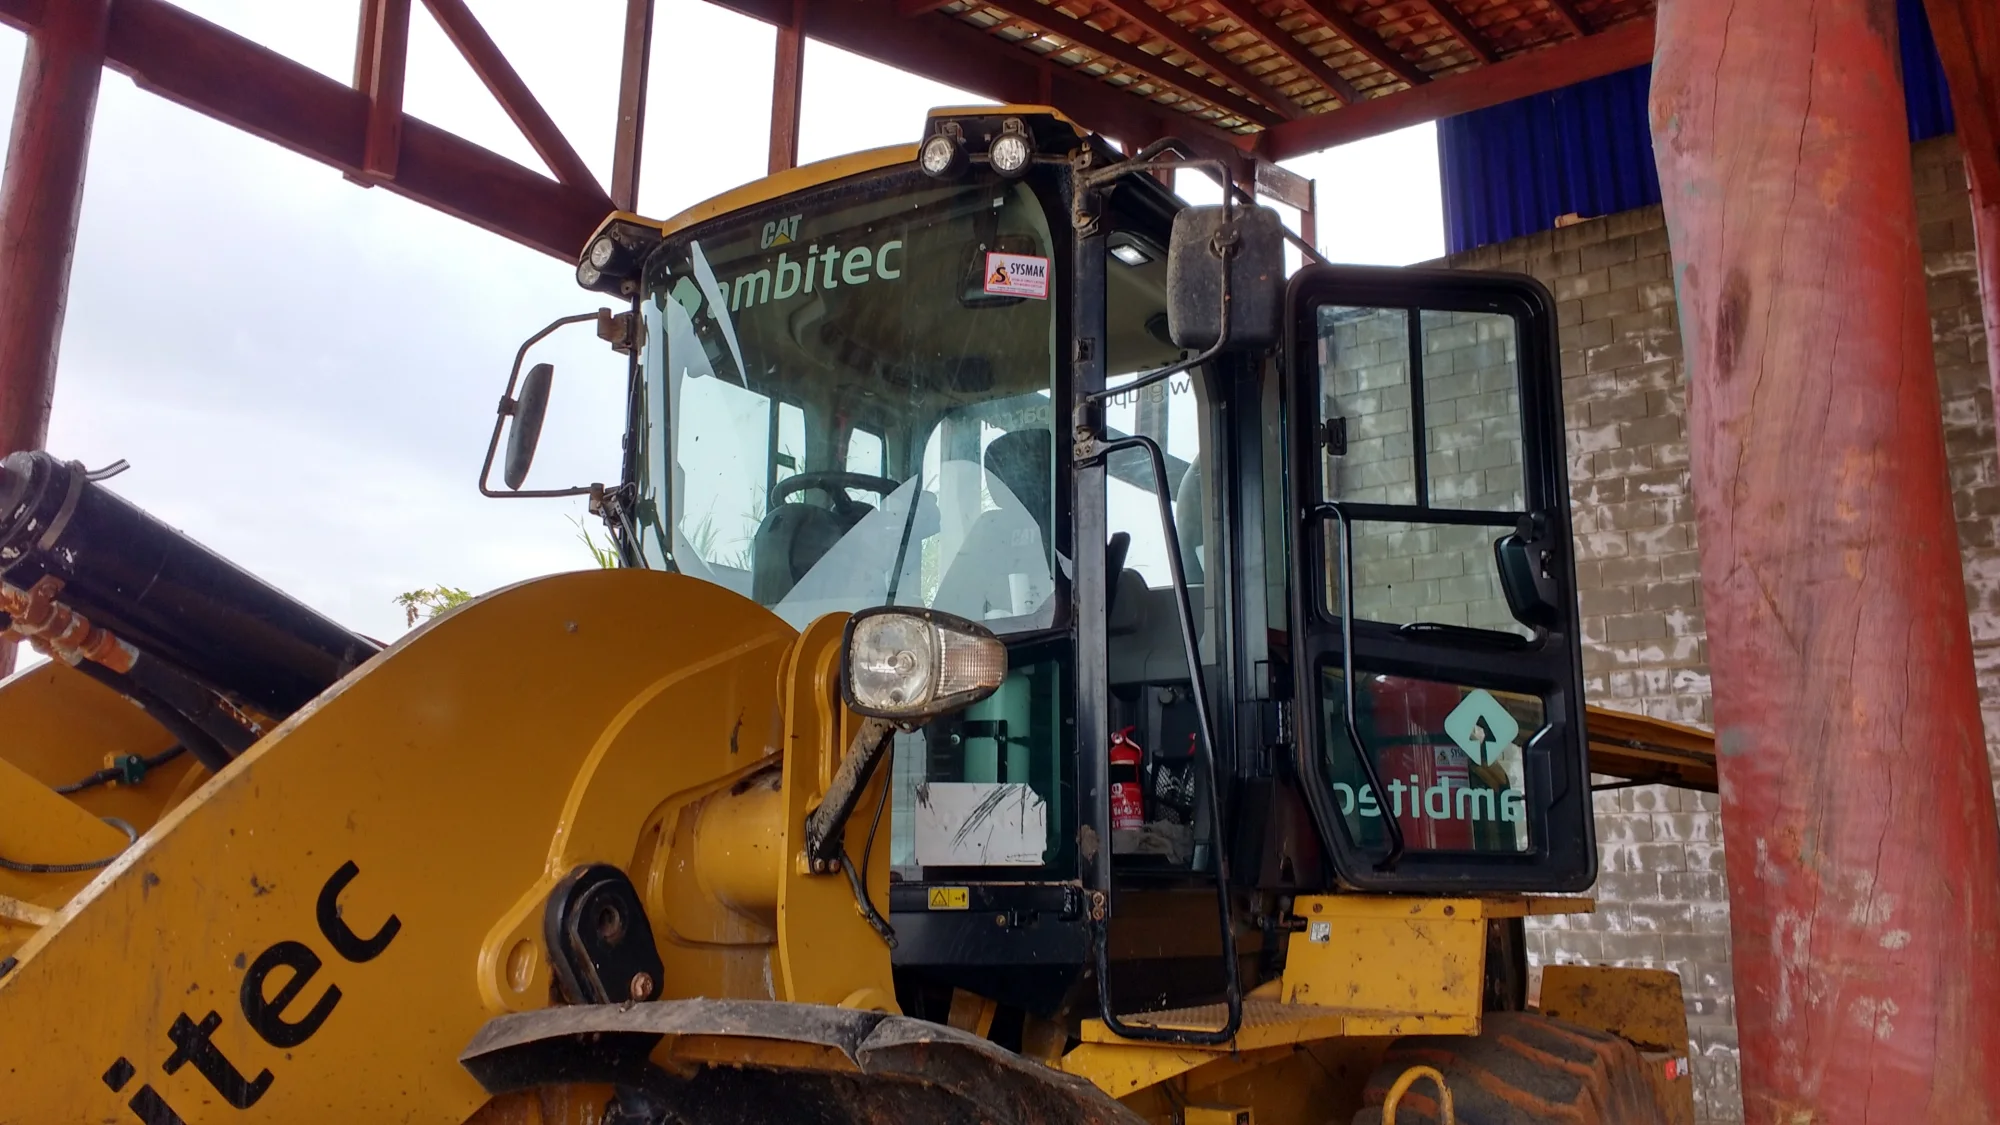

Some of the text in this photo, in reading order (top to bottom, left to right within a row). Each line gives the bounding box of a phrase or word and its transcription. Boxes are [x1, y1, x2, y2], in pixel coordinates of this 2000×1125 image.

[760, 213, 803, 250] CAT
[1010, 262, 1045, 278] SYSMAK
[102, 859, 402, 1125] itec
